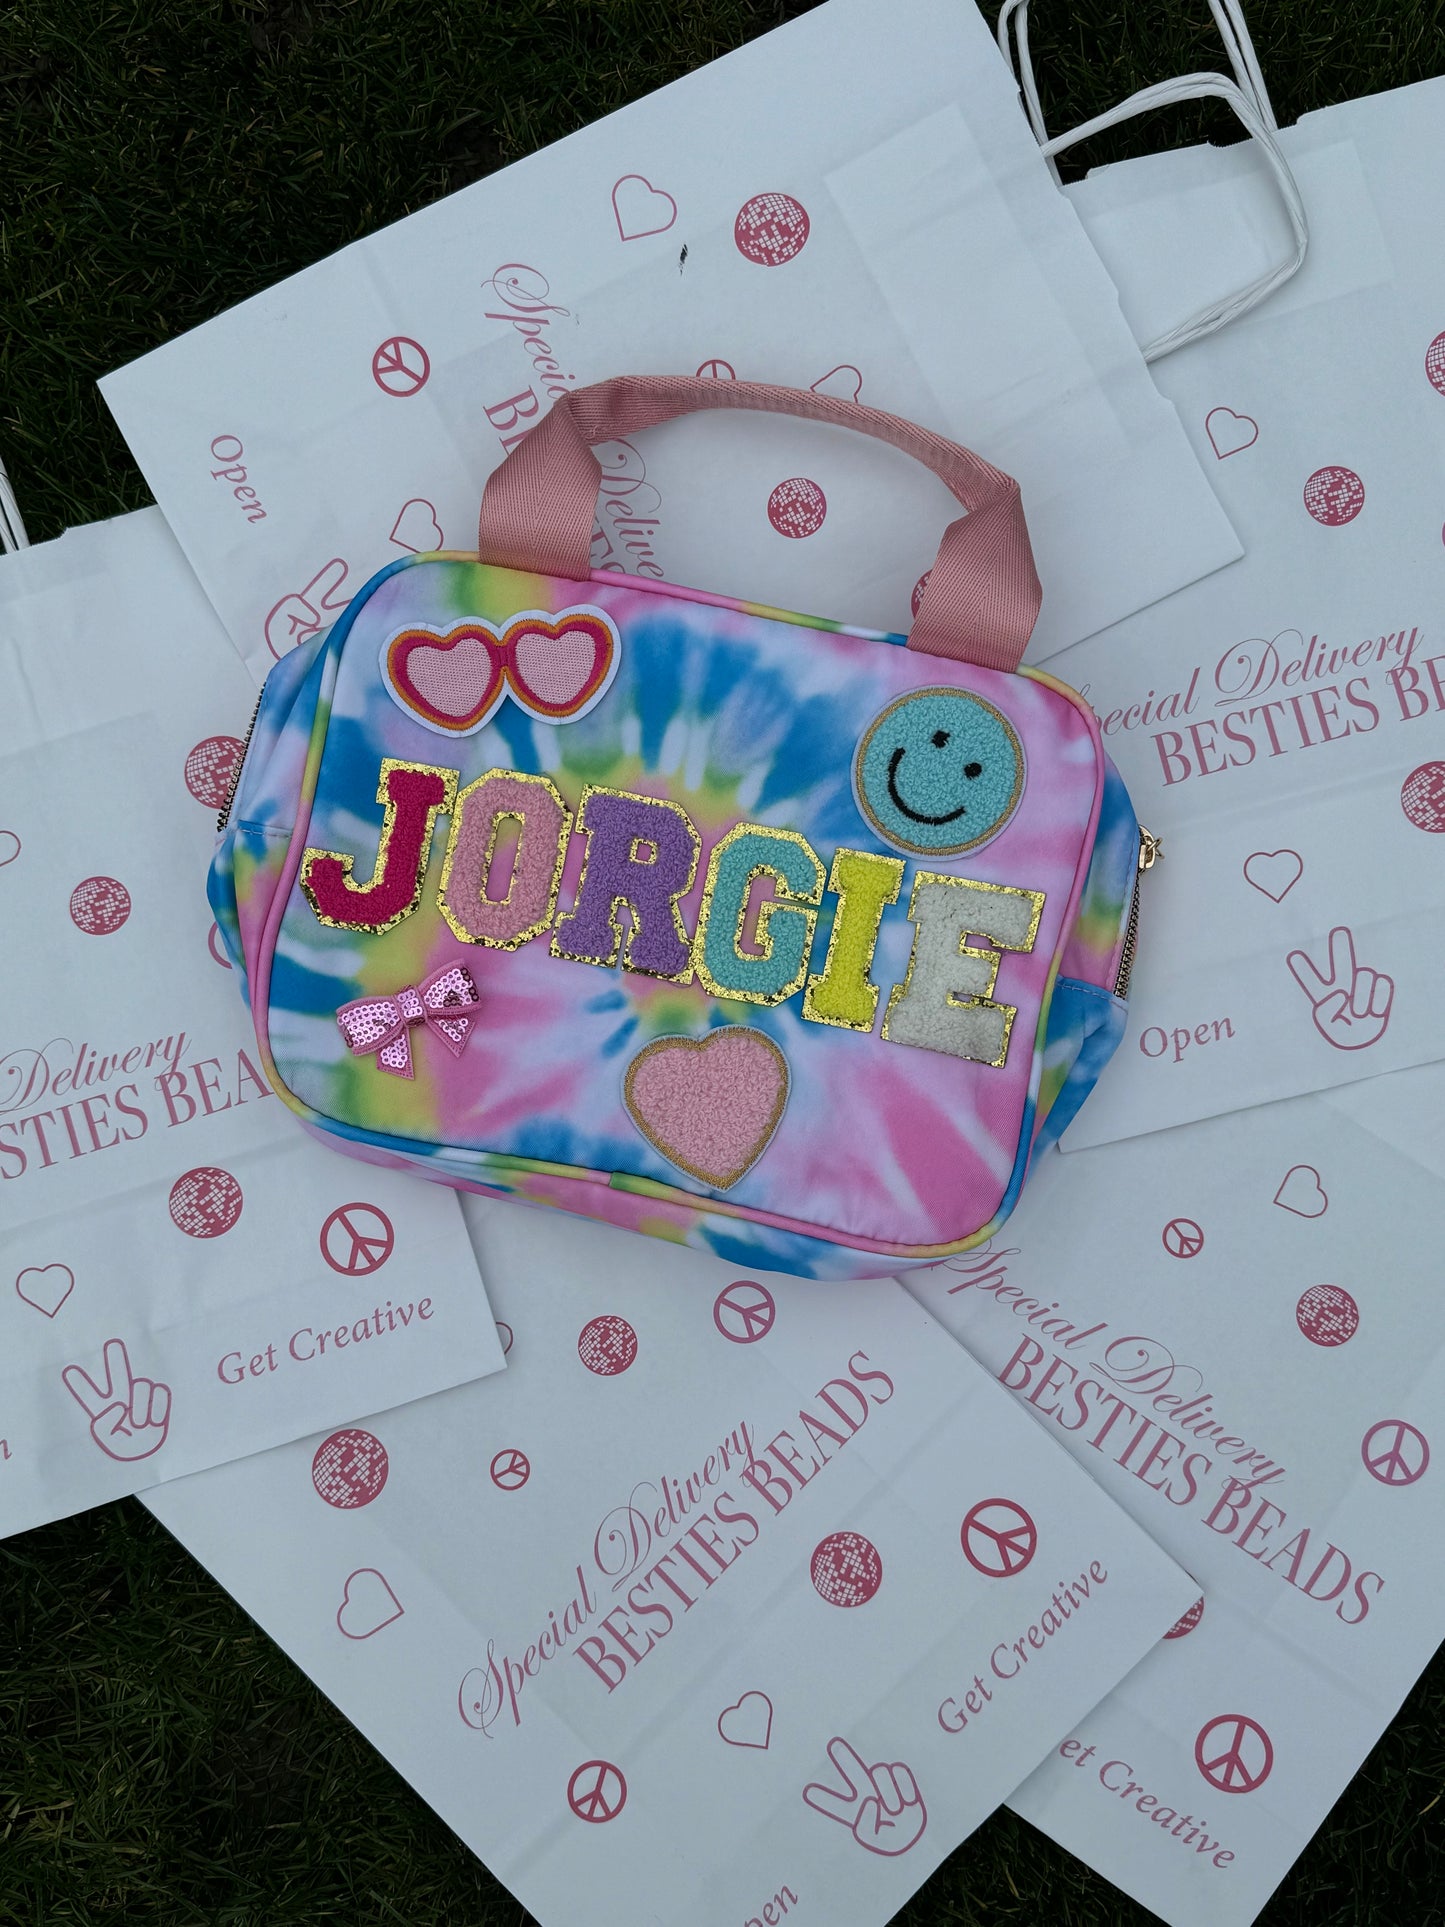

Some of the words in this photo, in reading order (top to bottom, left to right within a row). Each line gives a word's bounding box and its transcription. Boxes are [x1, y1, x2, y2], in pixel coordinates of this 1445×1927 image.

[210, 434, 267, 523] Open
[598, 437, 664, 578] Delive
[1150, 676, 1380, 787] BESTIES
[1213, 627, 1425, 708] Delivery
[300, 757, 1046, 1069] JORGIE
[0, 1031, 192, 1115] Delivery
[1139, 1017, 1236, 1064] Open
[0, 1083, 149, 1180] STIES
[154, 1047, 275, 1128] BEA
[217, 1343, 278, 1385] Get
[289, 1297, 435, 1362] Creative
[995, 1332, 1213, 1506] BESTIES
[1200, 1474, 1385, 1625] BEADS
[1088, 1335, 1286, 1491] Delivery
[457, 1564, 597, 1739] Special
[593, 1420, 755, 1592] Delivery
[571, 1490, 760, 1694] BESTIES
[738, 1349, 895, 1517] BEADS
[937, 1675, 994, 1734] Get
[989, 1559, 1109, 1680] Creative
[1058, 1738, 1097, 1768] et
[1098, 1759, 1236, 1869] Creative
